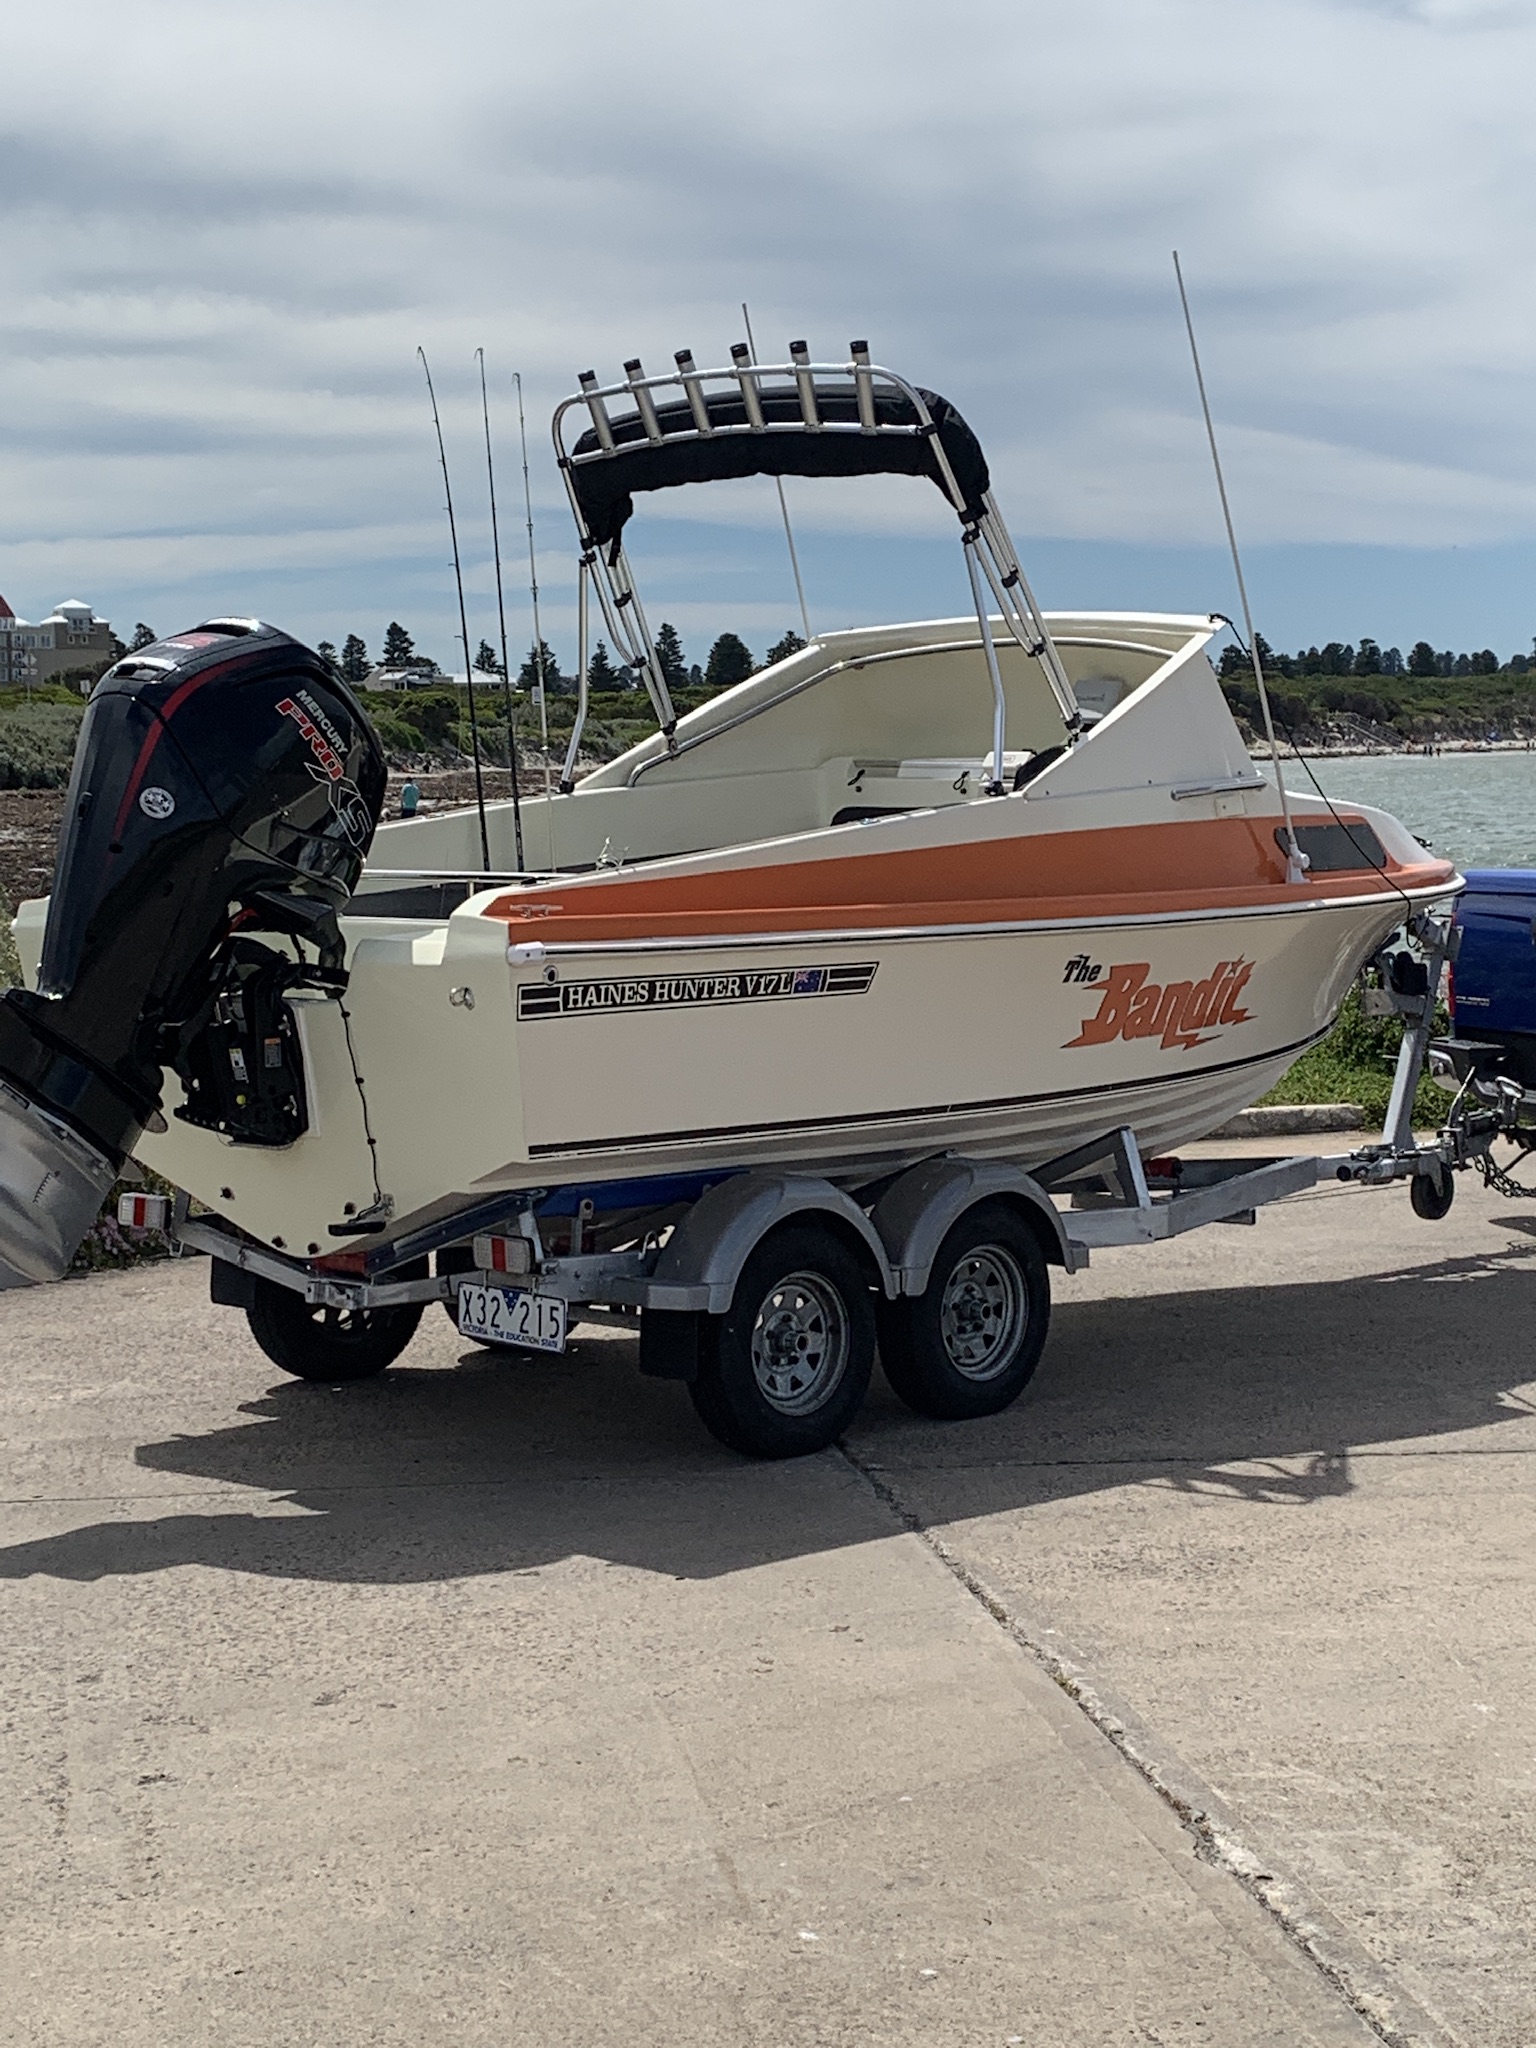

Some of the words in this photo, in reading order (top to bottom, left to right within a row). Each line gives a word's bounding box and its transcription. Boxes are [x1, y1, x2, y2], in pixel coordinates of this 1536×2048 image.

[275, 697, 344, 782] PRO
[296, 689, 349, 754] MERCURY
[303, 761, 373, 847] XS
[566, 981, 650, 1009] HAINES
[654, 976, 742, 1002] HUNTER
[745, 972, 793, 997] V17L
[1062, 954, 1103, 983] The
[1060, 953, 1259, 1051] Bandit
[462, 1289, 501, 1329] X32
[519, 1301, 561, 1339] 215
